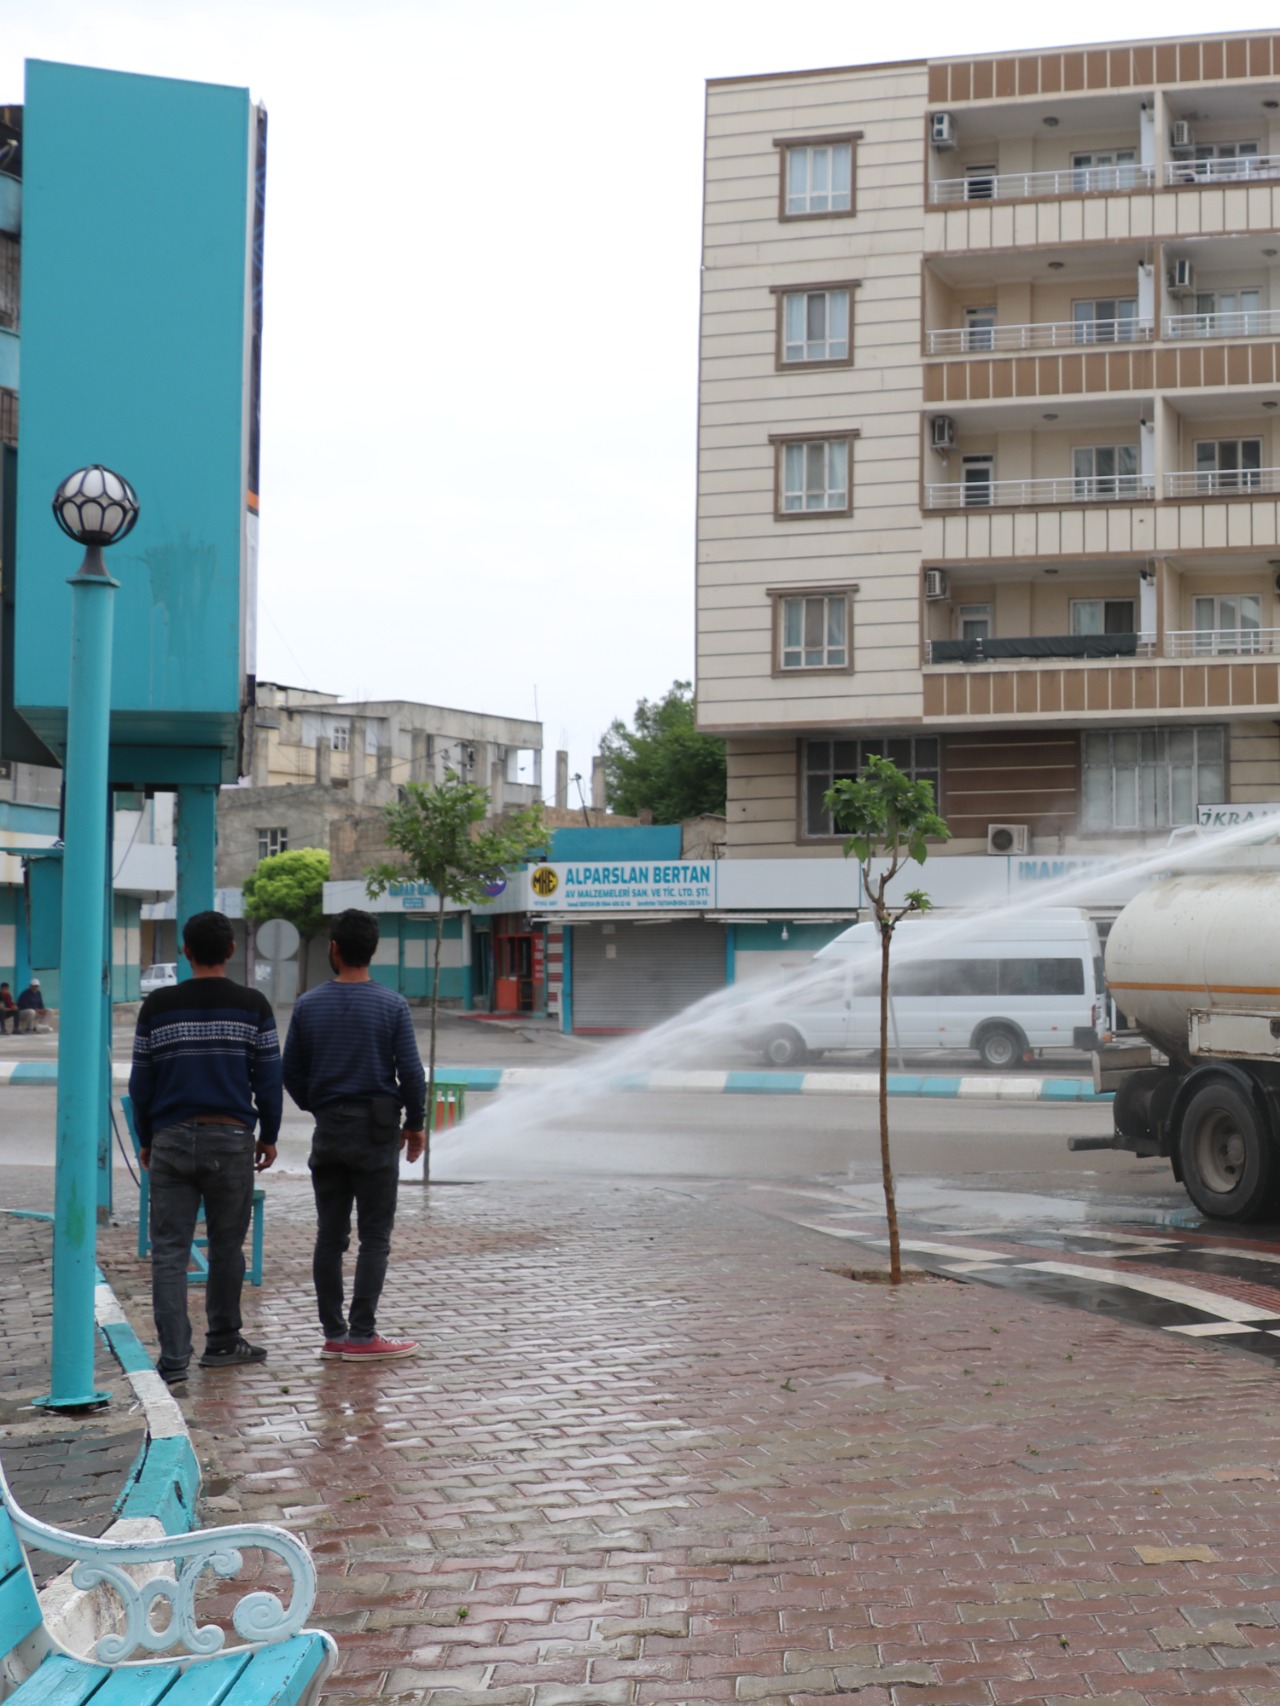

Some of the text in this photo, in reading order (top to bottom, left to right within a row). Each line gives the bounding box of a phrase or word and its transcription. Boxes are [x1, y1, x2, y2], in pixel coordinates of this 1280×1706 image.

[565, 866, 710, 885] ALPARSLAN BERTAN
[565, 889, 575, 898] AV
[577, 887, 630, 898] MALZEMELERİ
[632, 888, 649, 898] SAN.
[651, 888, 662, 897] VE
[678, 888, 694, 897] LTD.
